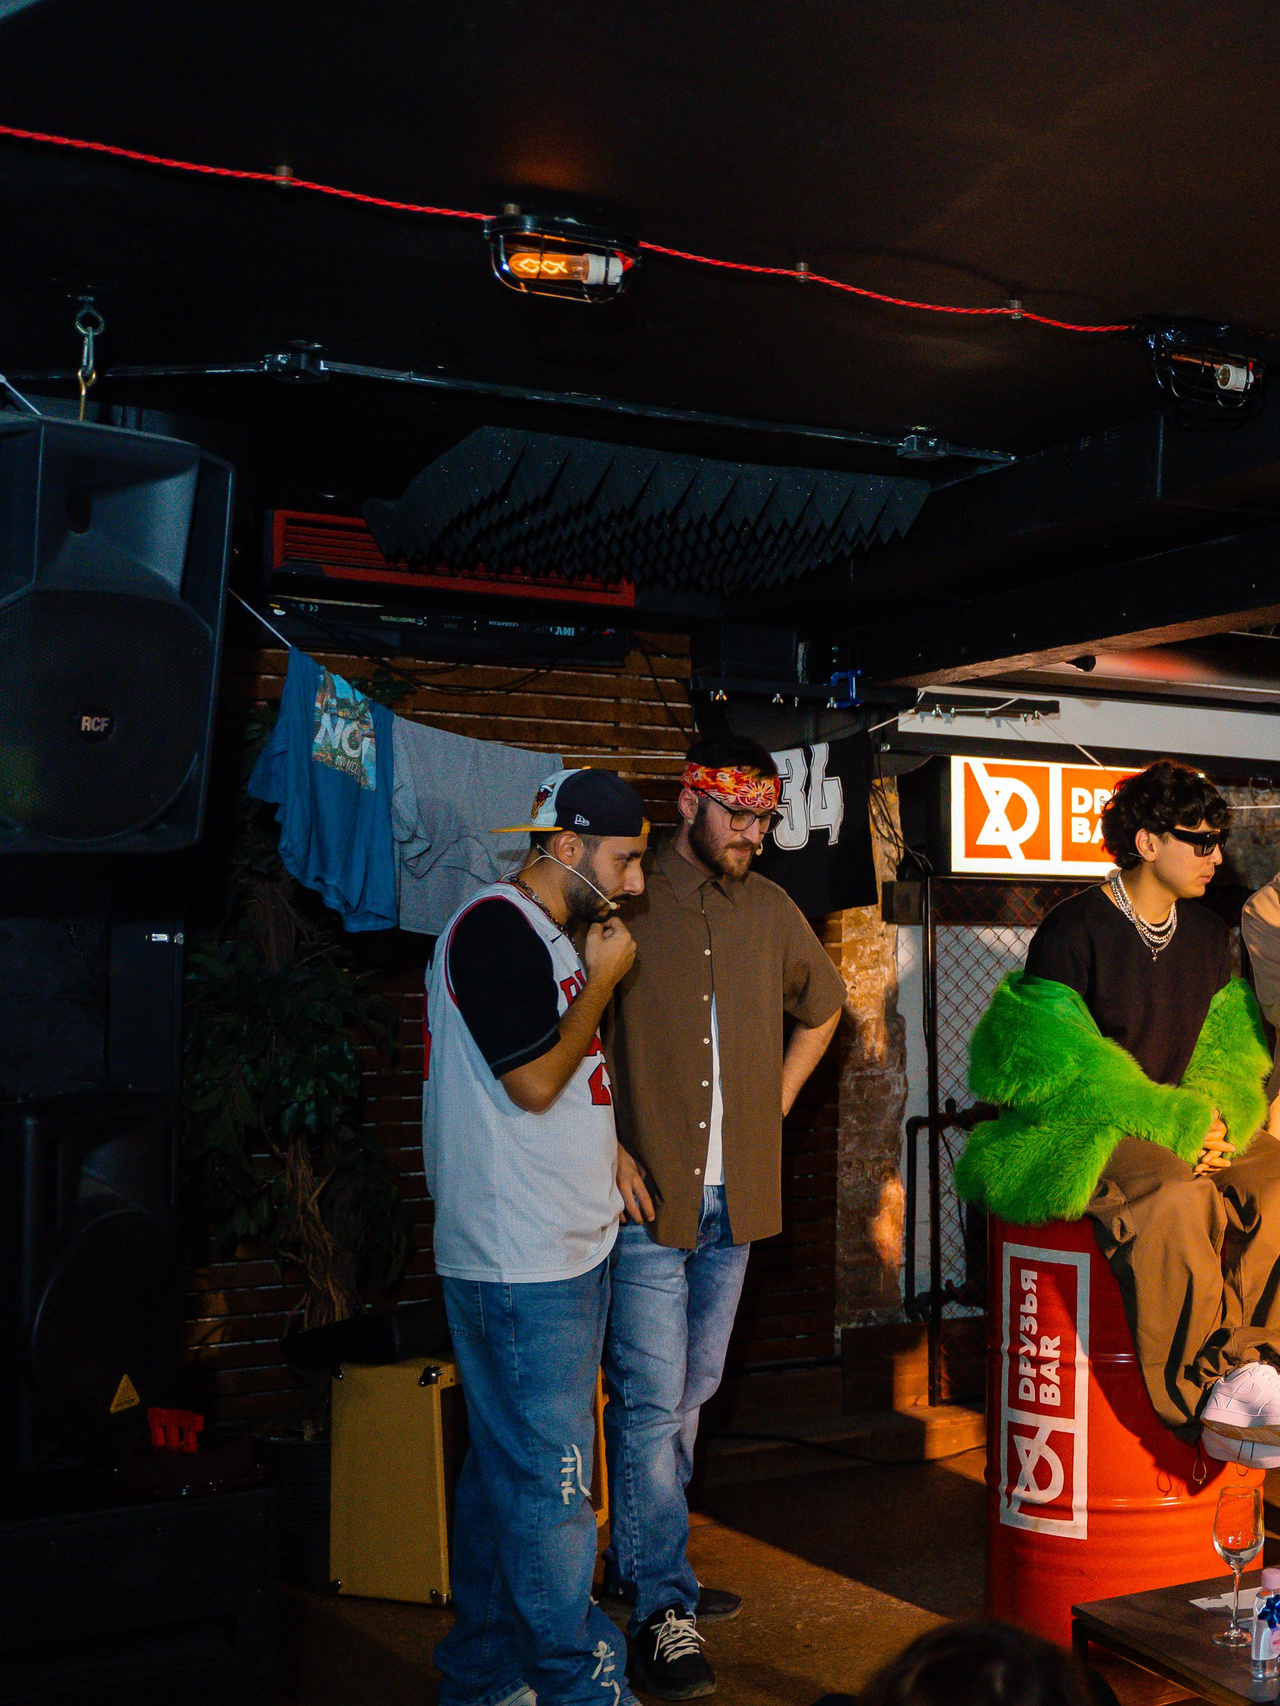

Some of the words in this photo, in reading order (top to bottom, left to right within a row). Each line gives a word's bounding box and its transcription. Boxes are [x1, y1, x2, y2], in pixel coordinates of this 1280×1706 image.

[81, 716, 110, 732] RCF
[770, 742, 844, 850] 34
[1039, 1335, 1061, 1407] BAR
